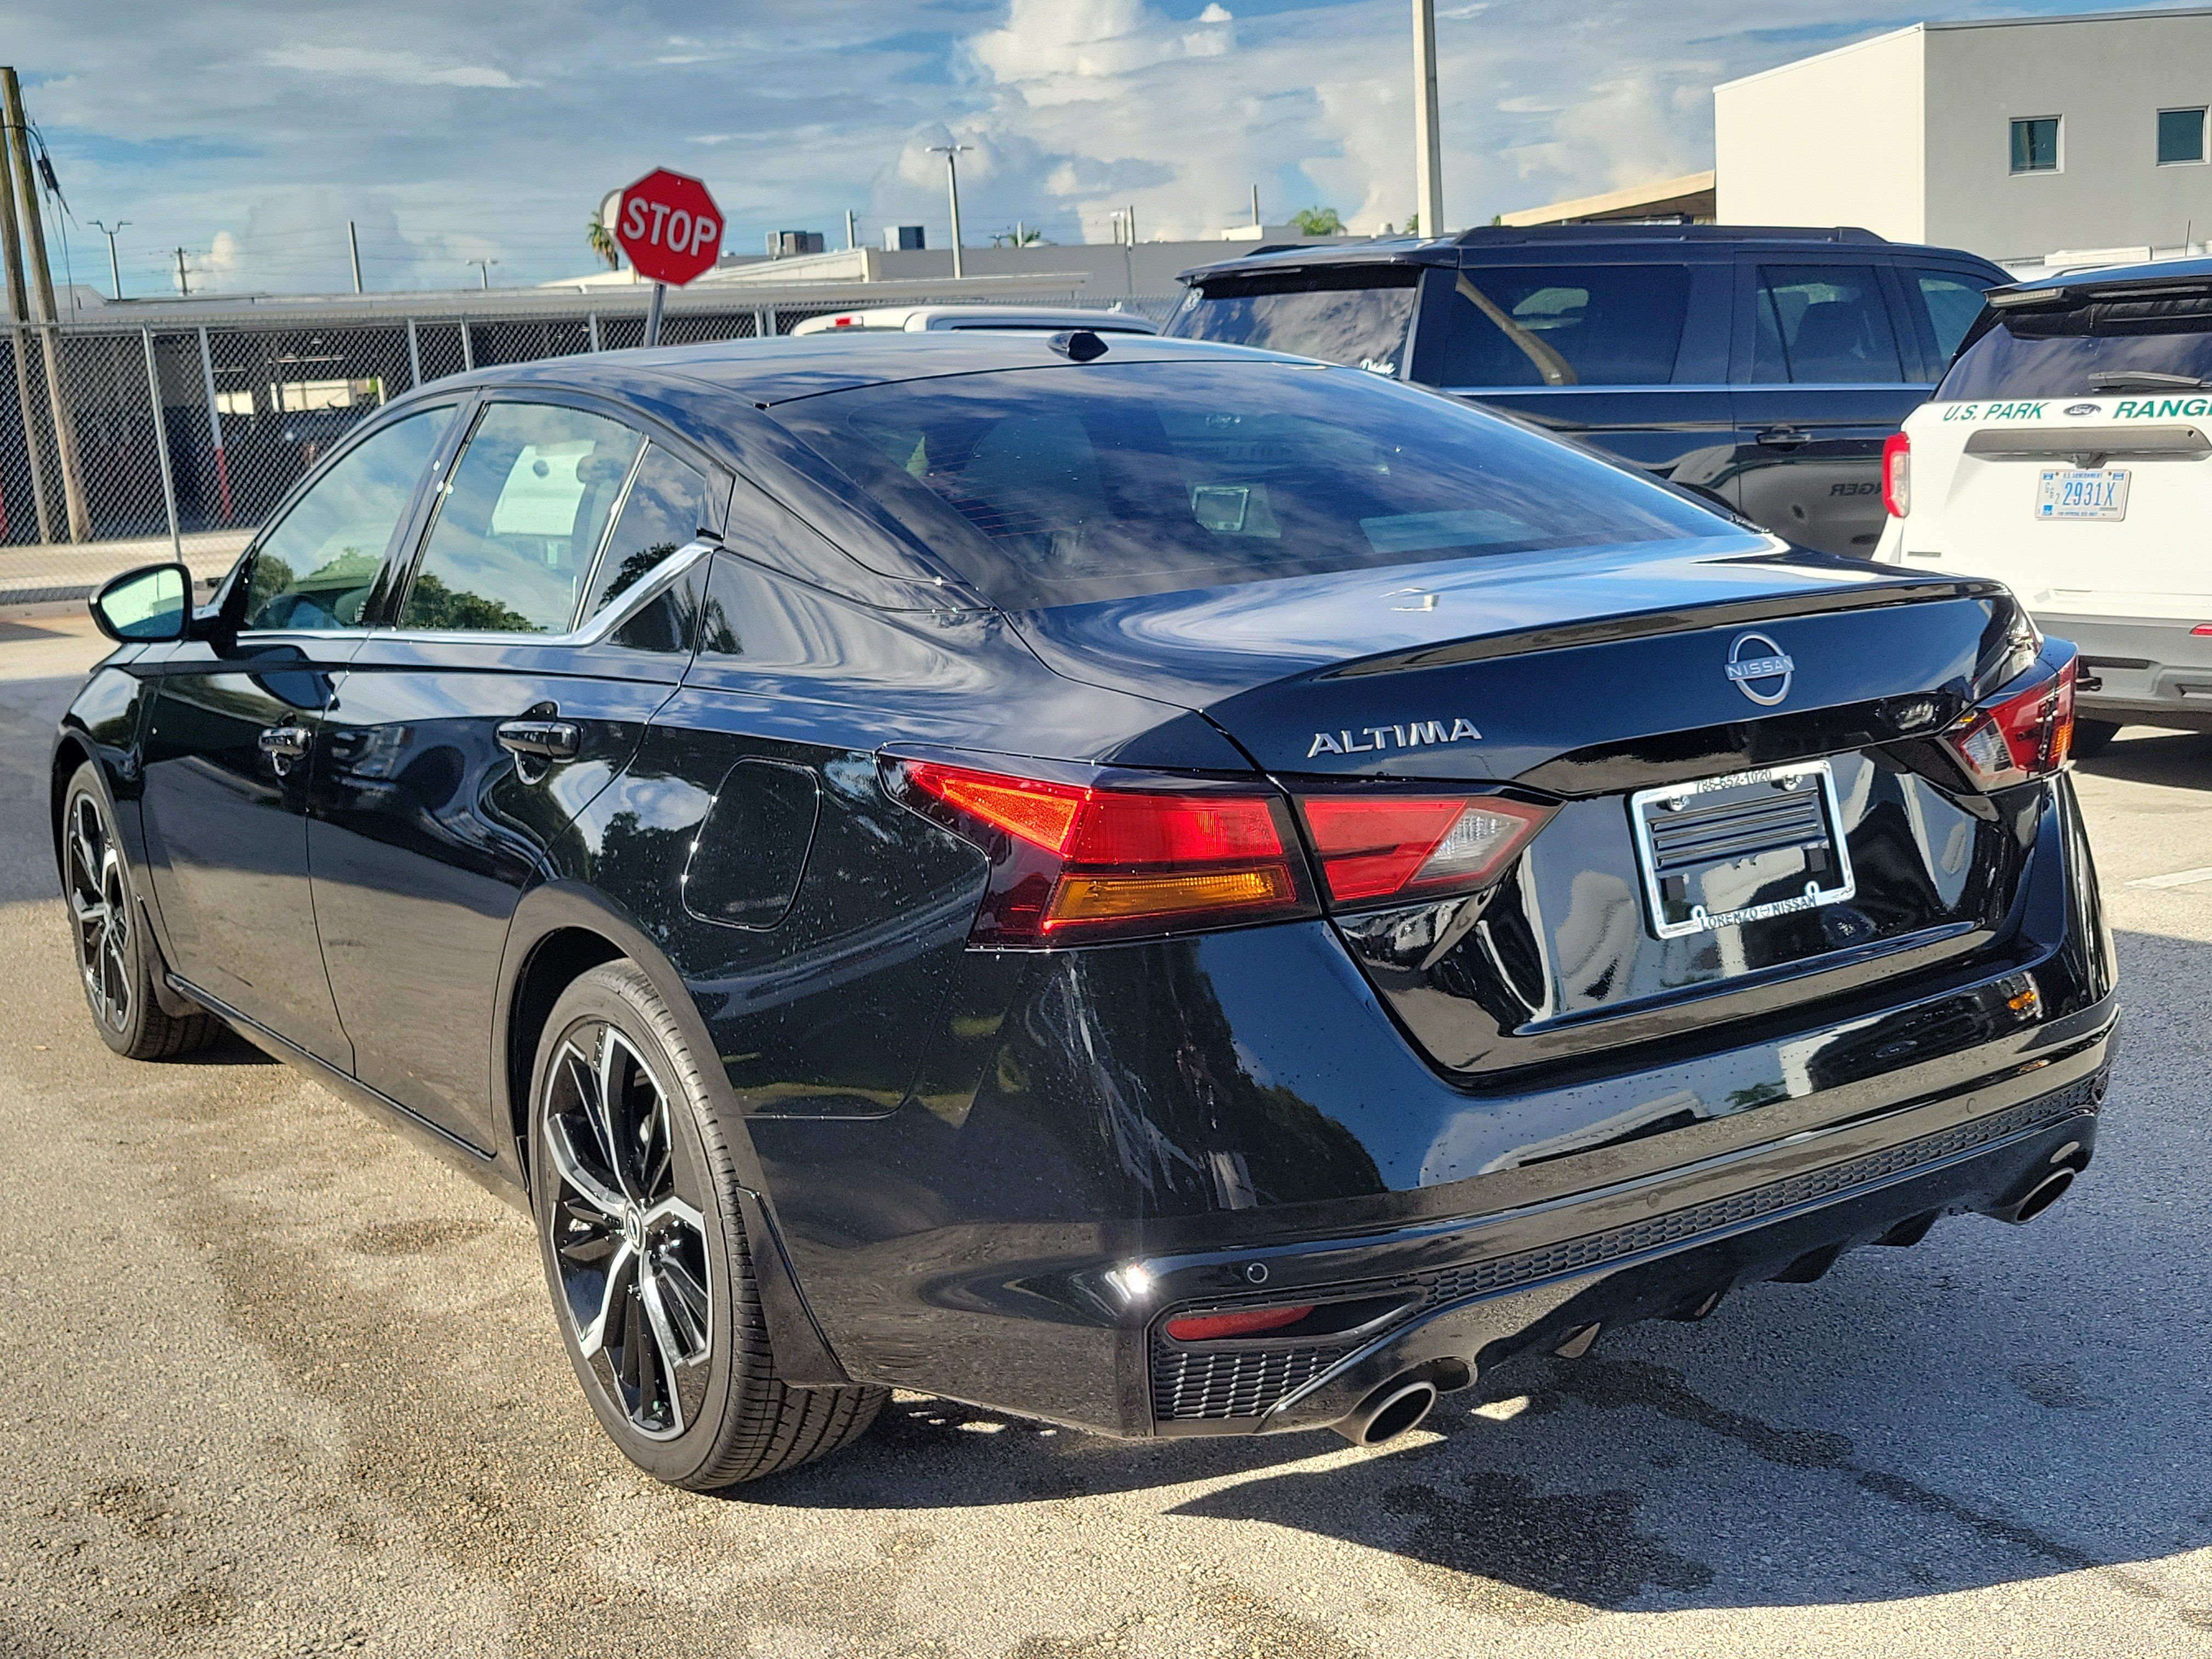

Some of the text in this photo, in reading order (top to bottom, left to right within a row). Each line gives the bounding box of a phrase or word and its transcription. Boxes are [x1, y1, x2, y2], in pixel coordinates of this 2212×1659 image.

[623, 196, 717, 257] STOP
[1943, 405, 1978, 421] U.S.
[1983, 402, 2051, 420] PARK
[2063, 482, 2115, 506] 2931X
[1728, 658, 1793, 677] NISSAN
[1307, 718, 1482, 758] ALTIMA
[1701, 895, 1816, 929] LORENZO NISSAN
